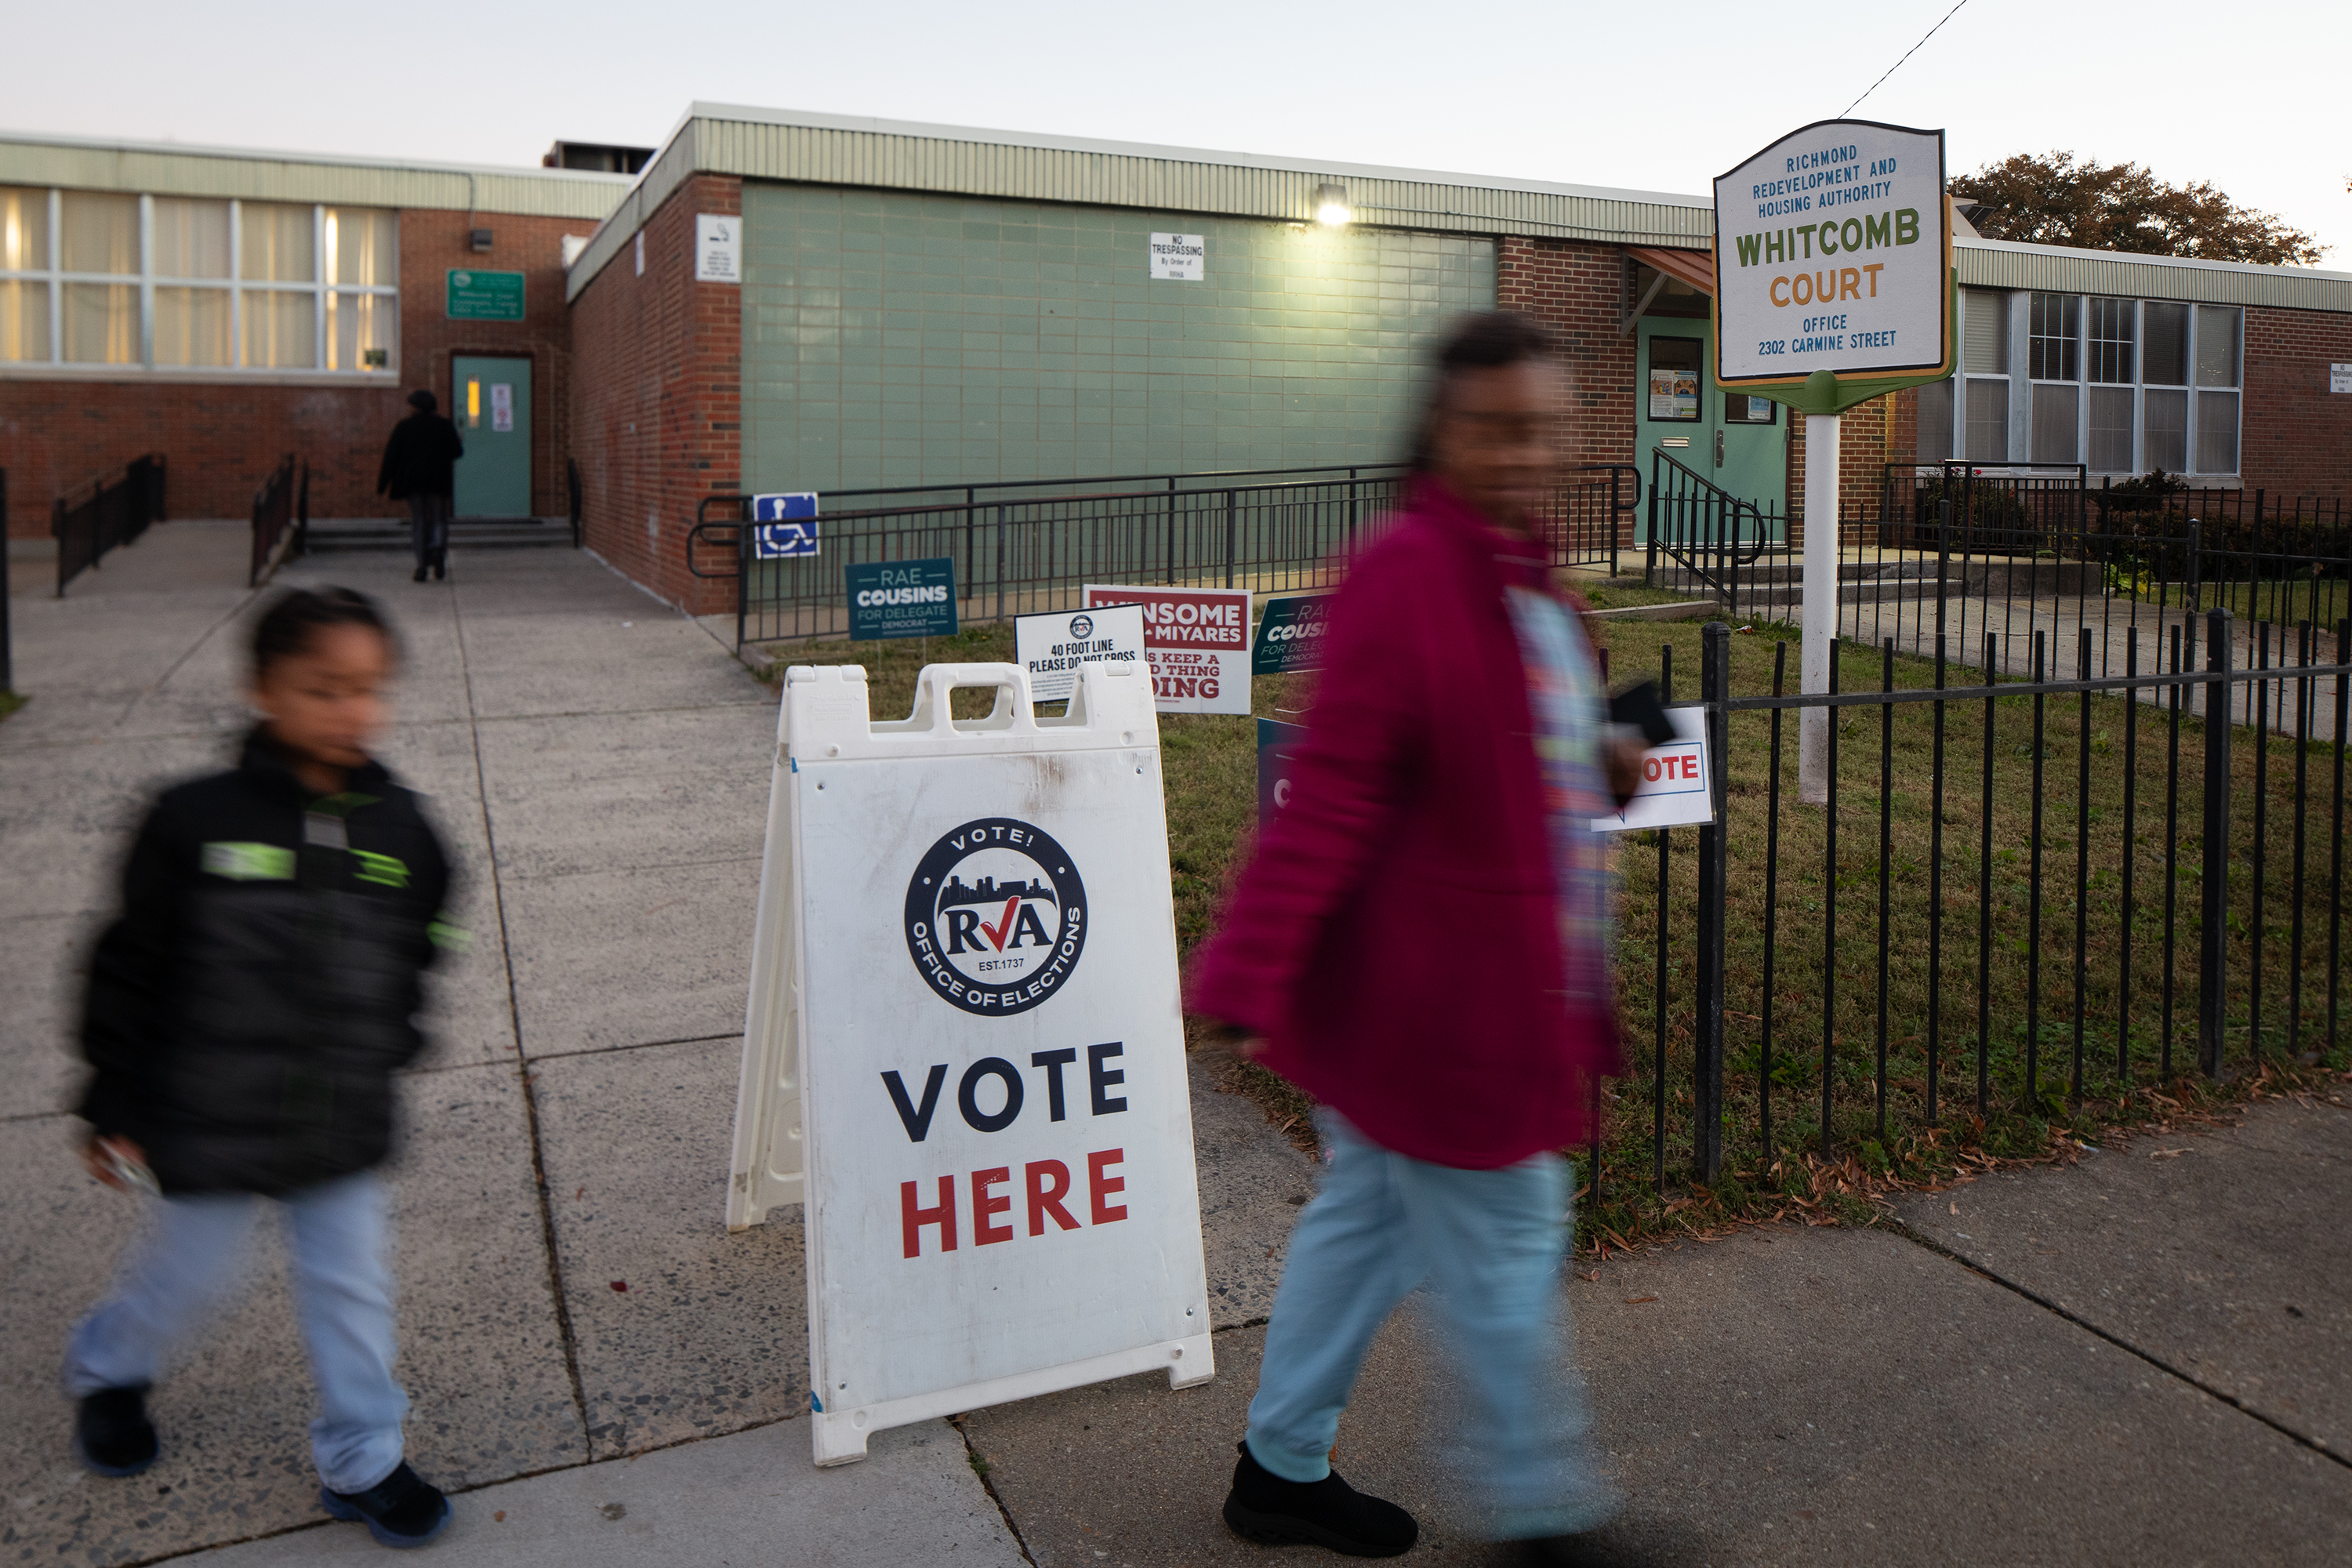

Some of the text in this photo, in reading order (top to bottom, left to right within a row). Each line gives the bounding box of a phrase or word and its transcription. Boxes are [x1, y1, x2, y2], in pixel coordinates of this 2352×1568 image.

[1787, 144, 1857, 172] RICHMOND
[1753, 158, 1896, 199] REDEVELOPMENT AND
[1759, 180, 1891, 218] HOUSING AUTHORITY
[1172, 235, 1183, 245] NO
[1736, 208, 1919, 267] WHITCOMB
[1152, 244, 1203, 256] TRESPASSING
[1161, 257, 1168, 266] By
[1769, 263, 1884, 307] COURT
[1803, 314, 1847, 332] OFFICE
[1759, 330, 1896, 355] 2302 CARMINE STREET
[881, 568, 922, 586] RAE
[857, 585, 948, 607] COUSINS
[858, 604, 947, 620] FOR DELEGATE
[1096, 601, 1240, 626] NSOME
[881, 619, 928, 629] DEMOCRAT
[1267, 621, 1330, 642] COUSI
[1155, 626, 1241, 643] MIYARES
[1051, 639, 1113, 656] 40 FOOT LINE
[1261, 640, 1327, 655] FOR DELEG
[1029, 658, 1065, 673] PLEASE
[1068, 656, 1081, 669] DO
[1162, 653, 1202, 664] KEEP
[1207, 655, 1220, 664] A
[1167, 665, 1220, 677] THING
[1642, 754, 1698, 782] OTE
[951, 826, 1033, 851] VOTE!
[913, 906, 1080, 1007] OFFICE OF ELECTIONS
[978, 958, 1024, 971] EST.1737
[880, 1041, 1127, 1142] VOTE
[901, 1147, 1128, 1259] HERE
